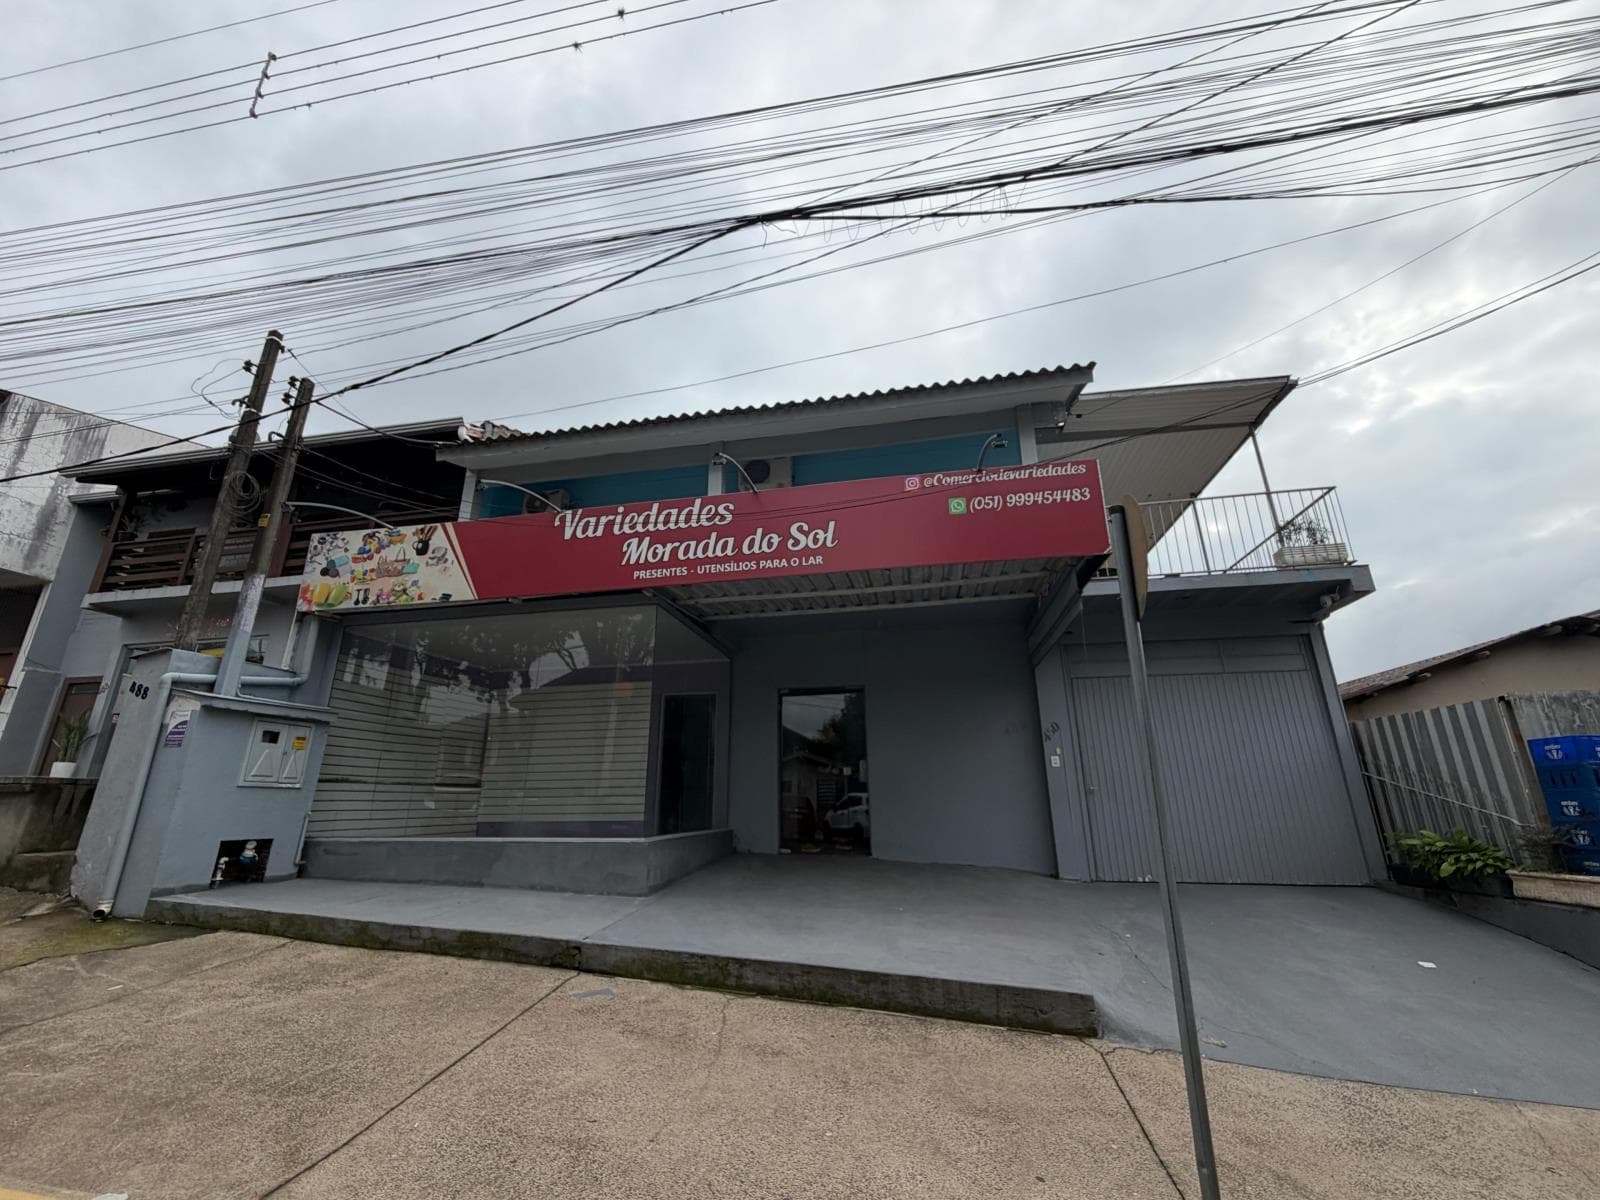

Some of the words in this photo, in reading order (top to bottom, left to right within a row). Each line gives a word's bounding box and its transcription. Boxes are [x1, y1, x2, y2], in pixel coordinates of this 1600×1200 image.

[970, 496, 1003, 513] (051)
[1006, 488, 1090, 507] 999454483
[554, 498, 735, 539] Variedades
[621, 532, 737, 566] Morada
[742, 528, 782, 556] do
[787, 521, 838, 551] Sol
[633, 566, 687, 580] PRESENTES
[697, 560, 756, 575] UTENSÍLIOS
[759, 559, 787, 569] PARA
[790, 558, 799, 567] O
[802, 555, 823, 566] LAR
[130, 683, 149, 700] 488
